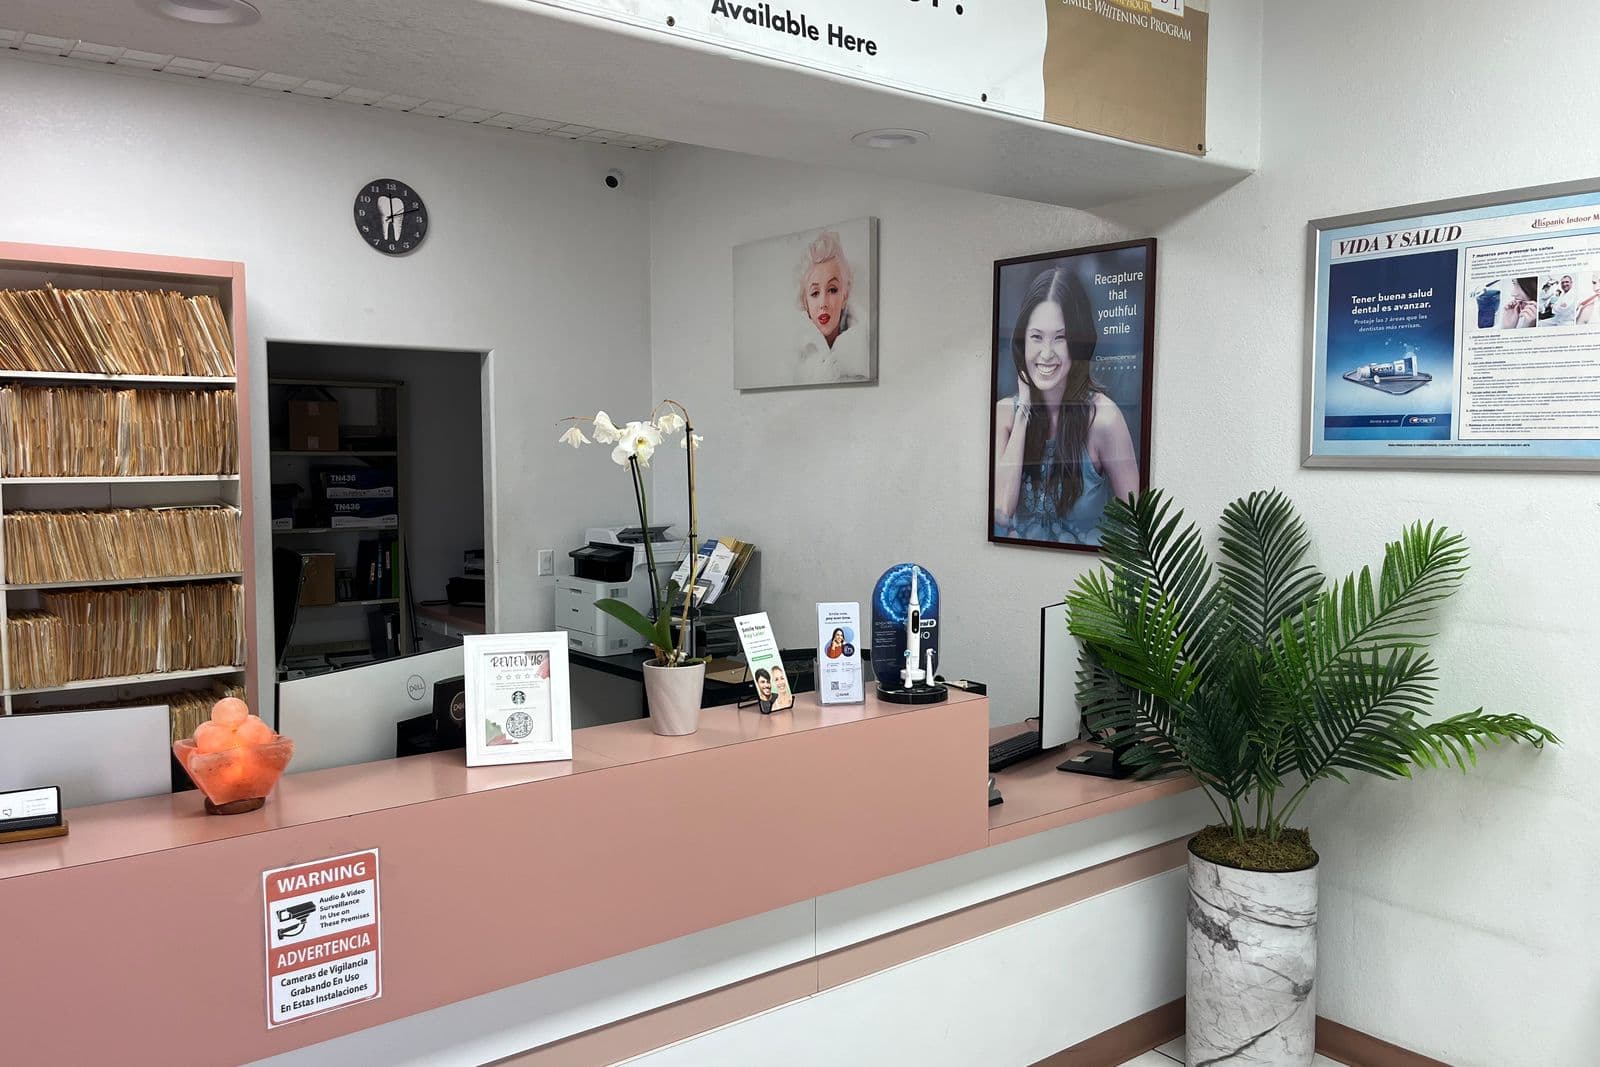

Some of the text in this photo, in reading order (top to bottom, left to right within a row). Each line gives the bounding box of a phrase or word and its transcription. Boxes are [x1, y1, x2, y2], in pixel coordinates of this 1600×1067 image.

[711, 0, 877, 56] Available Here
[1093, 1, 1149, 28] WHITENING
[1150, 16, 1192, 42] PROGRAM
[1533, 216, 1565, 228] Hispanic
[1566, 216, 1592, 224] Indoor
[1340, 225, 1462, 256] VIDA Y SALUD
[1094, 271, 1144, 286] Recapture
[1108, 289, 1127, 301] that
[1352, 288, 1432, 304] Tener buena salud
[1098, 304, 1137, 321] youthful
[1352, 304, 1380, 314] dental
[1394, 302, 1431, 311] avanzar.
[1104, 323, 1130, 335] smile
[490, 654, 543, 668] REVIEW US
[277, 861, 366, 894] WARNING
[320, 892, 339, 904] Audio
[346, 888, 366, 898] Video
[320, 898, 360, 912] Surveillance
[320, 912, 370, 929] These Premises
[328, 910, 340, 920] Use
[277, 932, 371, 968] ADVERTENCIA
[281, 957, 368, 987] Cameras de Vigilancia
[290, 972, 360, 998] Grabando En Uso
[281, 983, 368, 1014] En Estas Instalaciones
